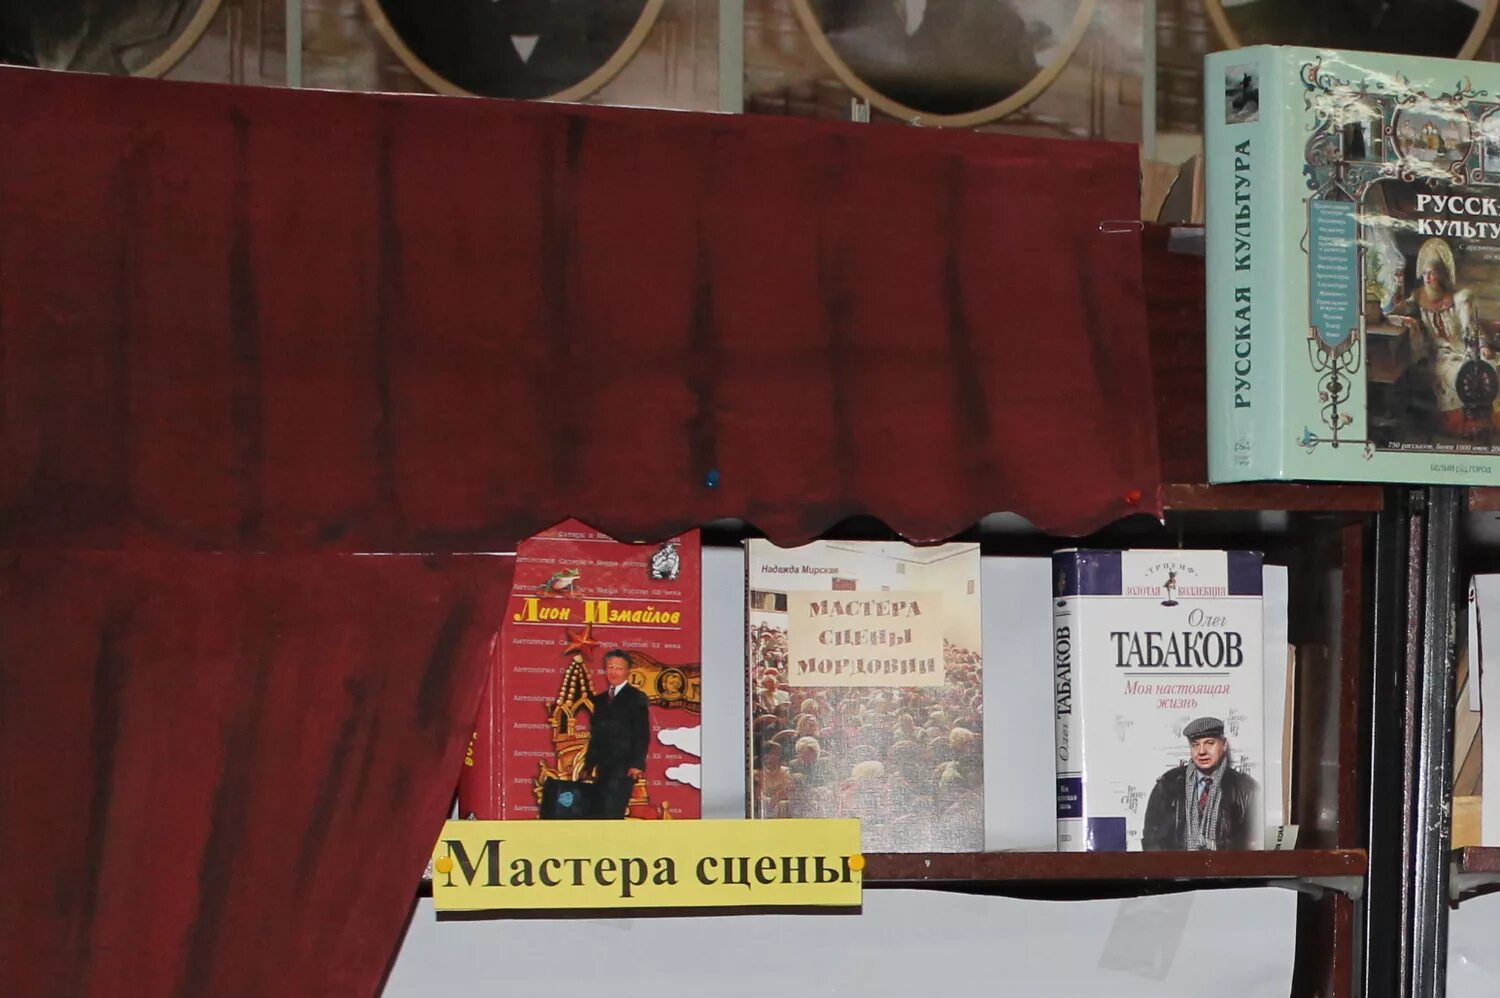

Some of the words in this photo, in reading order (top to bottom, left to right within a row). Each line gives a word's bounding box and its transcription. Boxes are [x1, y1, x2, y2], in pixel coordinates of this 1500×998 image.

[1235, 138, 1252, 272] КУЛЬТУРА
[1235, 286, 1252, 409] РУССКАЯ
[761, 565, 799, 575] Надежда
[801, 566, 839, 575] Мирская
[513, 598, 571, 622] Лион
[582, 599, 681, 625] Измайлов
[808, 600, 922, 618] МАСТЕРА
[1188, 608, 1227, 628] Олег
[818, 628, 913, 649] СЦЕНЫ
[1110, 631, 1244, 668] ТАБАКОВ
[797, 657, 936, 678] МОРДОВИИ
[1056, 625, 1073, 720] ТАБАКОВ
[1124, 680, 1151, 695] Моя
[1155, 682, 1230, 697] настоящая
[1156, 698, 1198, 709] жизнь
[441, 838, 678, 898] Мастера
[695, 853, 854, 892] сцены
